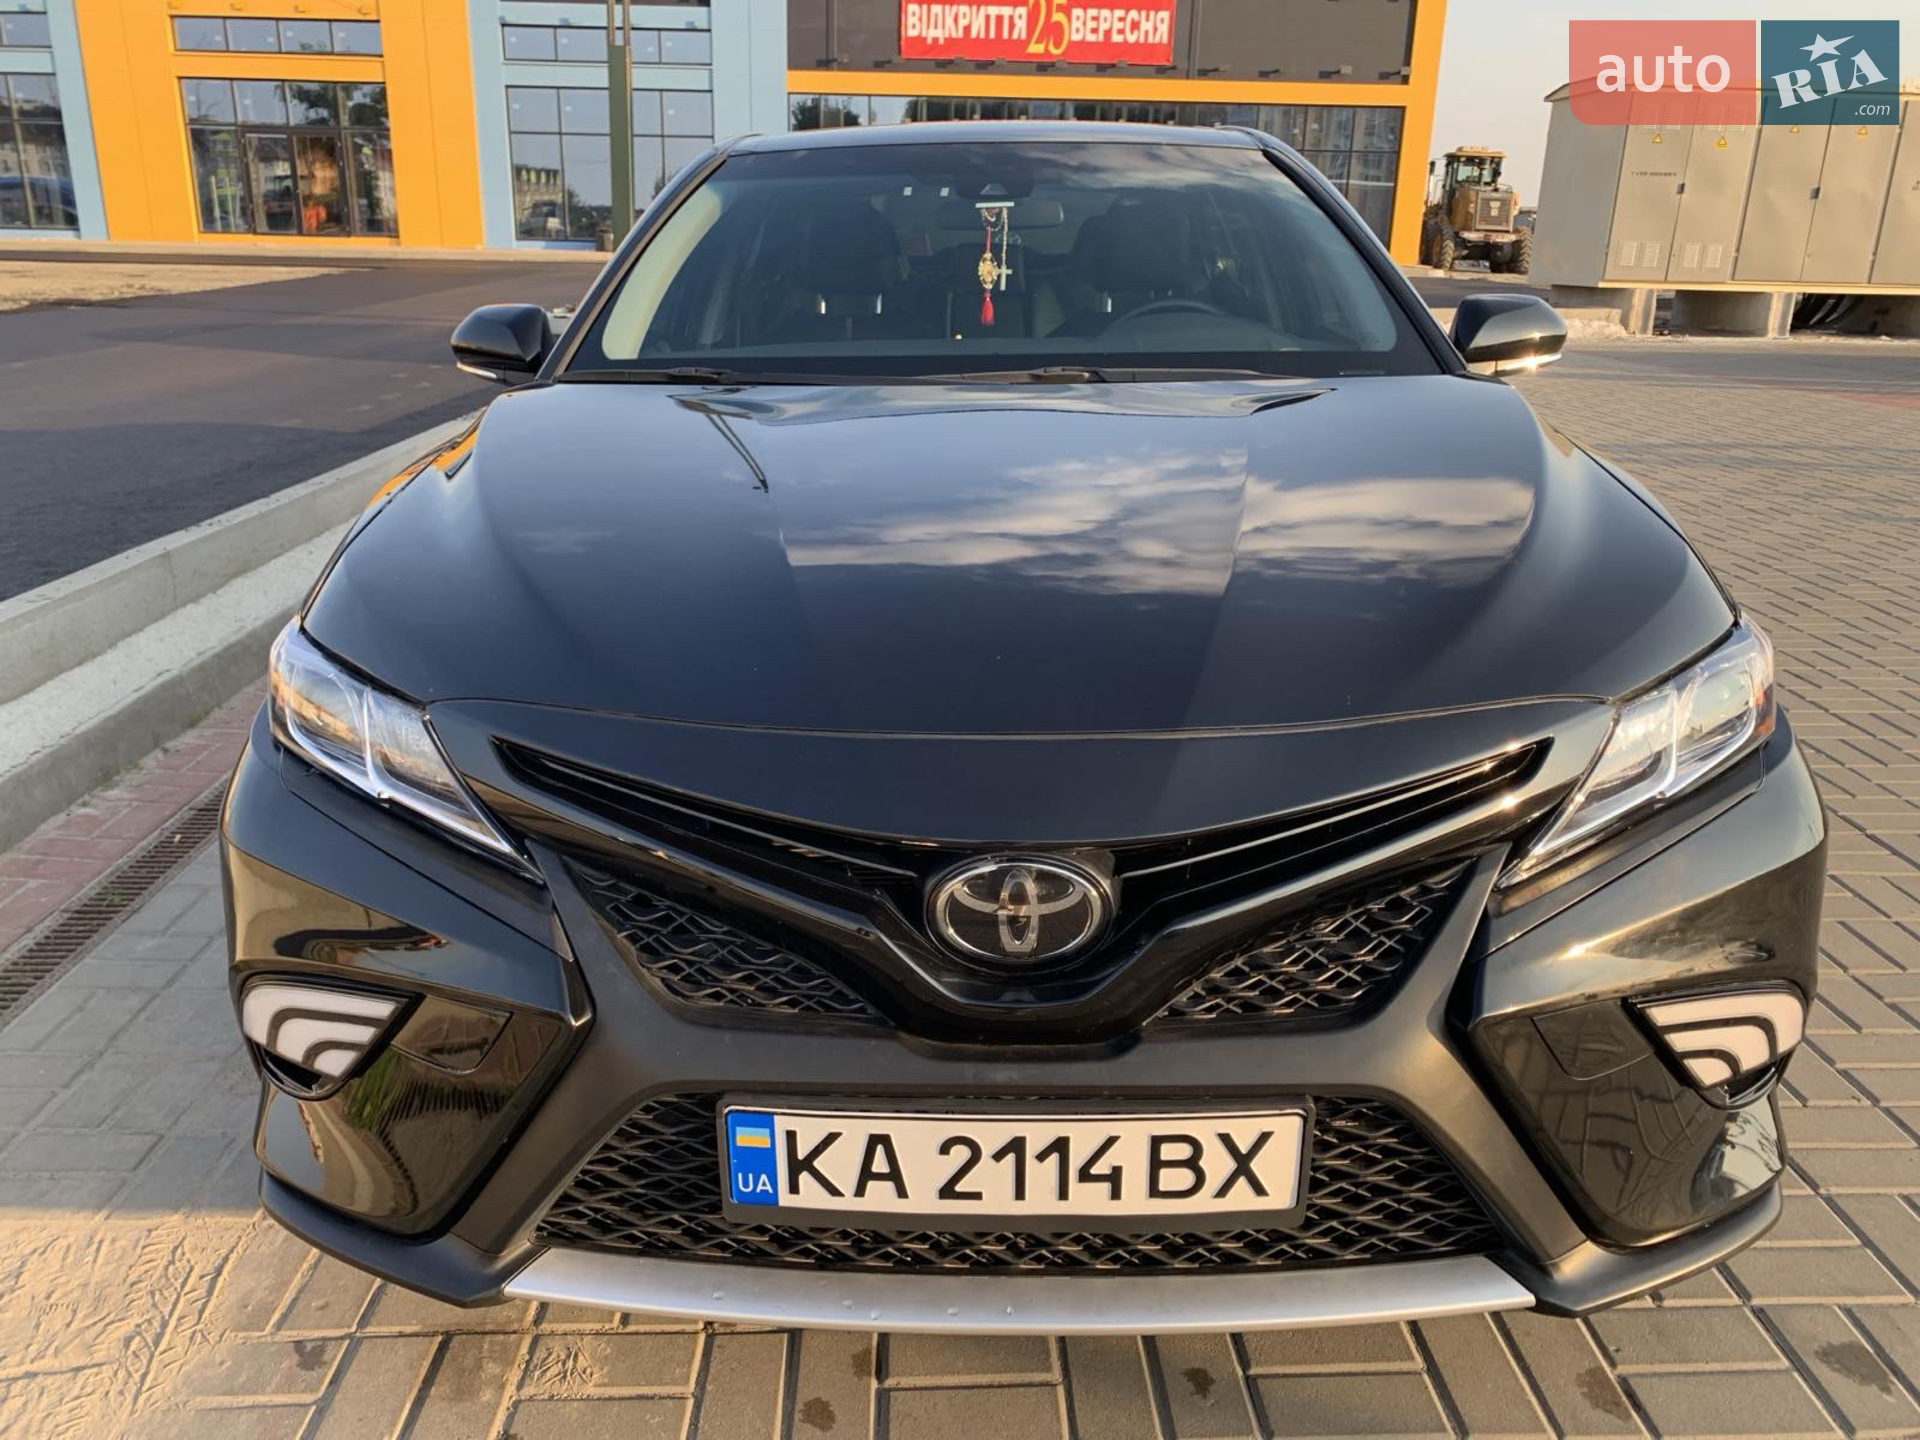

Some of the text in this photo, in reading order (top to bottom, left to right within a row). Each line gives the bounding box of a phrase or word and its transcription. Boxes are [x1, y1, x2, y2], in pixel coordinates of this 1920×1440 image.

[906, 0, 1171, 55] ВІДКРИТТЯ 25 ВЕРЕСНЯ
[738, 1172, 774, 1195] UA
[783, 1129, 1275, 1201] KA 2114 BX
